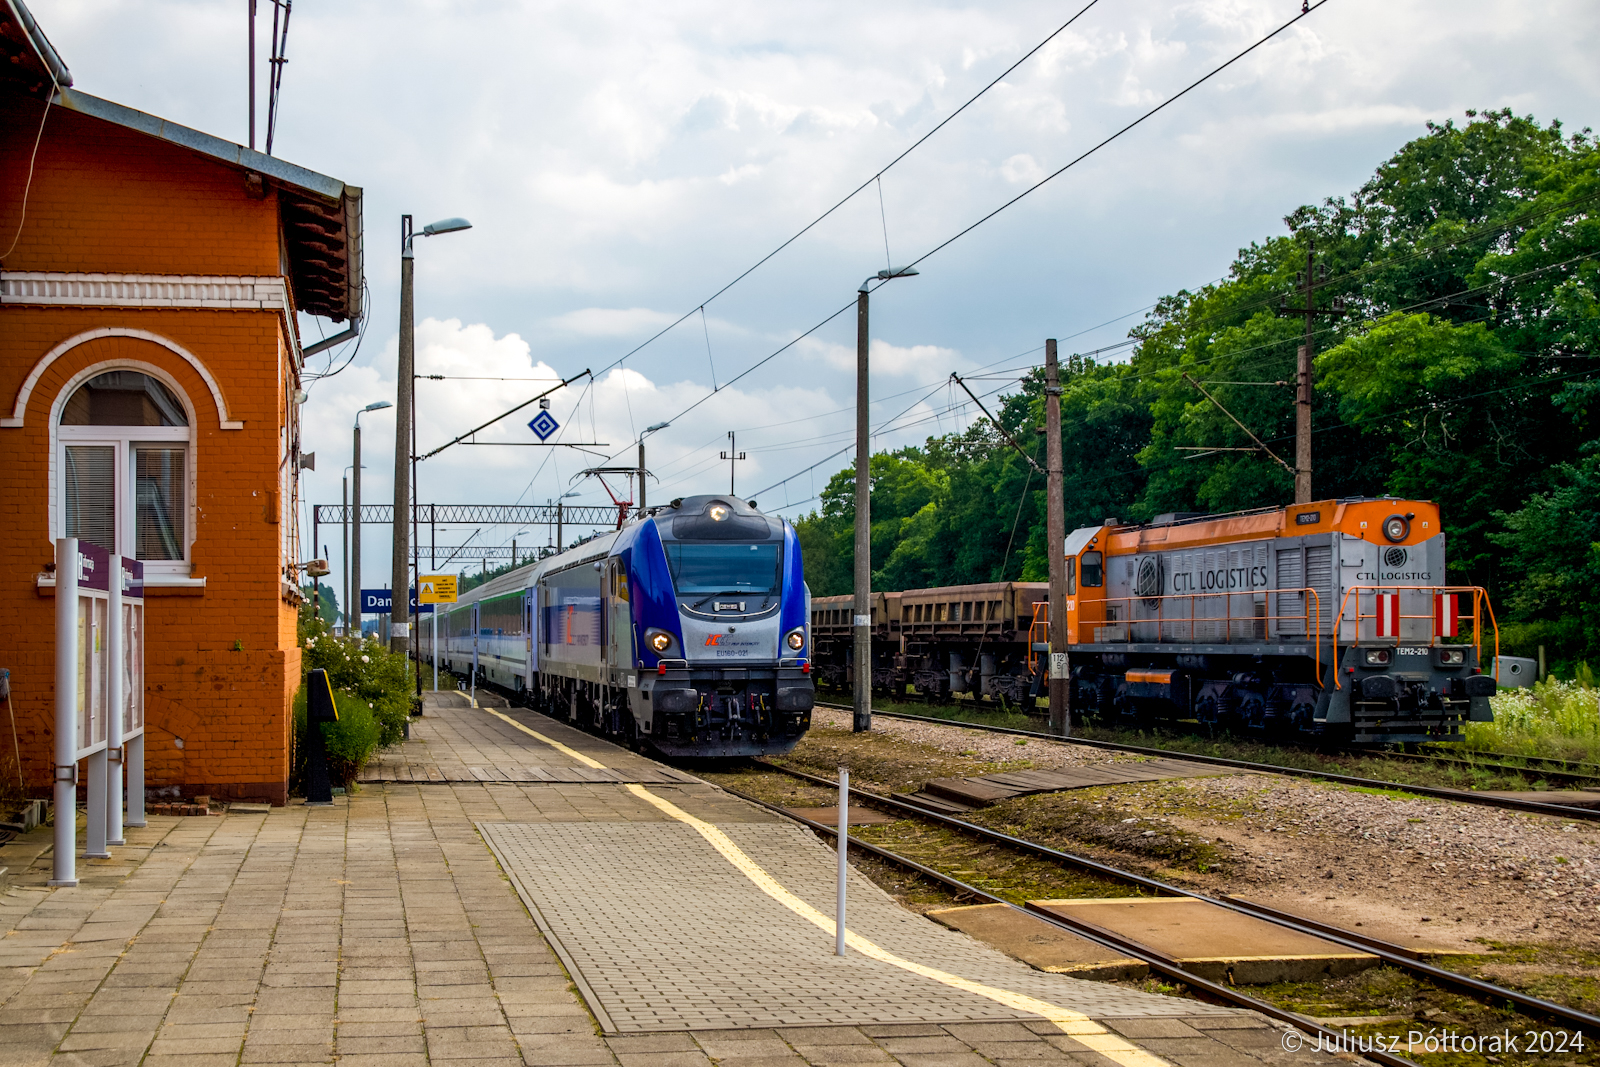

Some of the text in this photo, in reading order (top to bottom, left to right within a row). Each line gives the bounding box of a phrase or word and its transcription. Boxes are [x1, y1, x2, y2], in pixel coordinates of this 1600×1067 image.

[1173, 566, 1267, 592] CTL LOGISTICS
[1356, 572, 1431, 580] CTL LOGISTICS
[716, 649, 749, 657] EU160-021
[1396, 647, 1429, 656] TEM2-210
